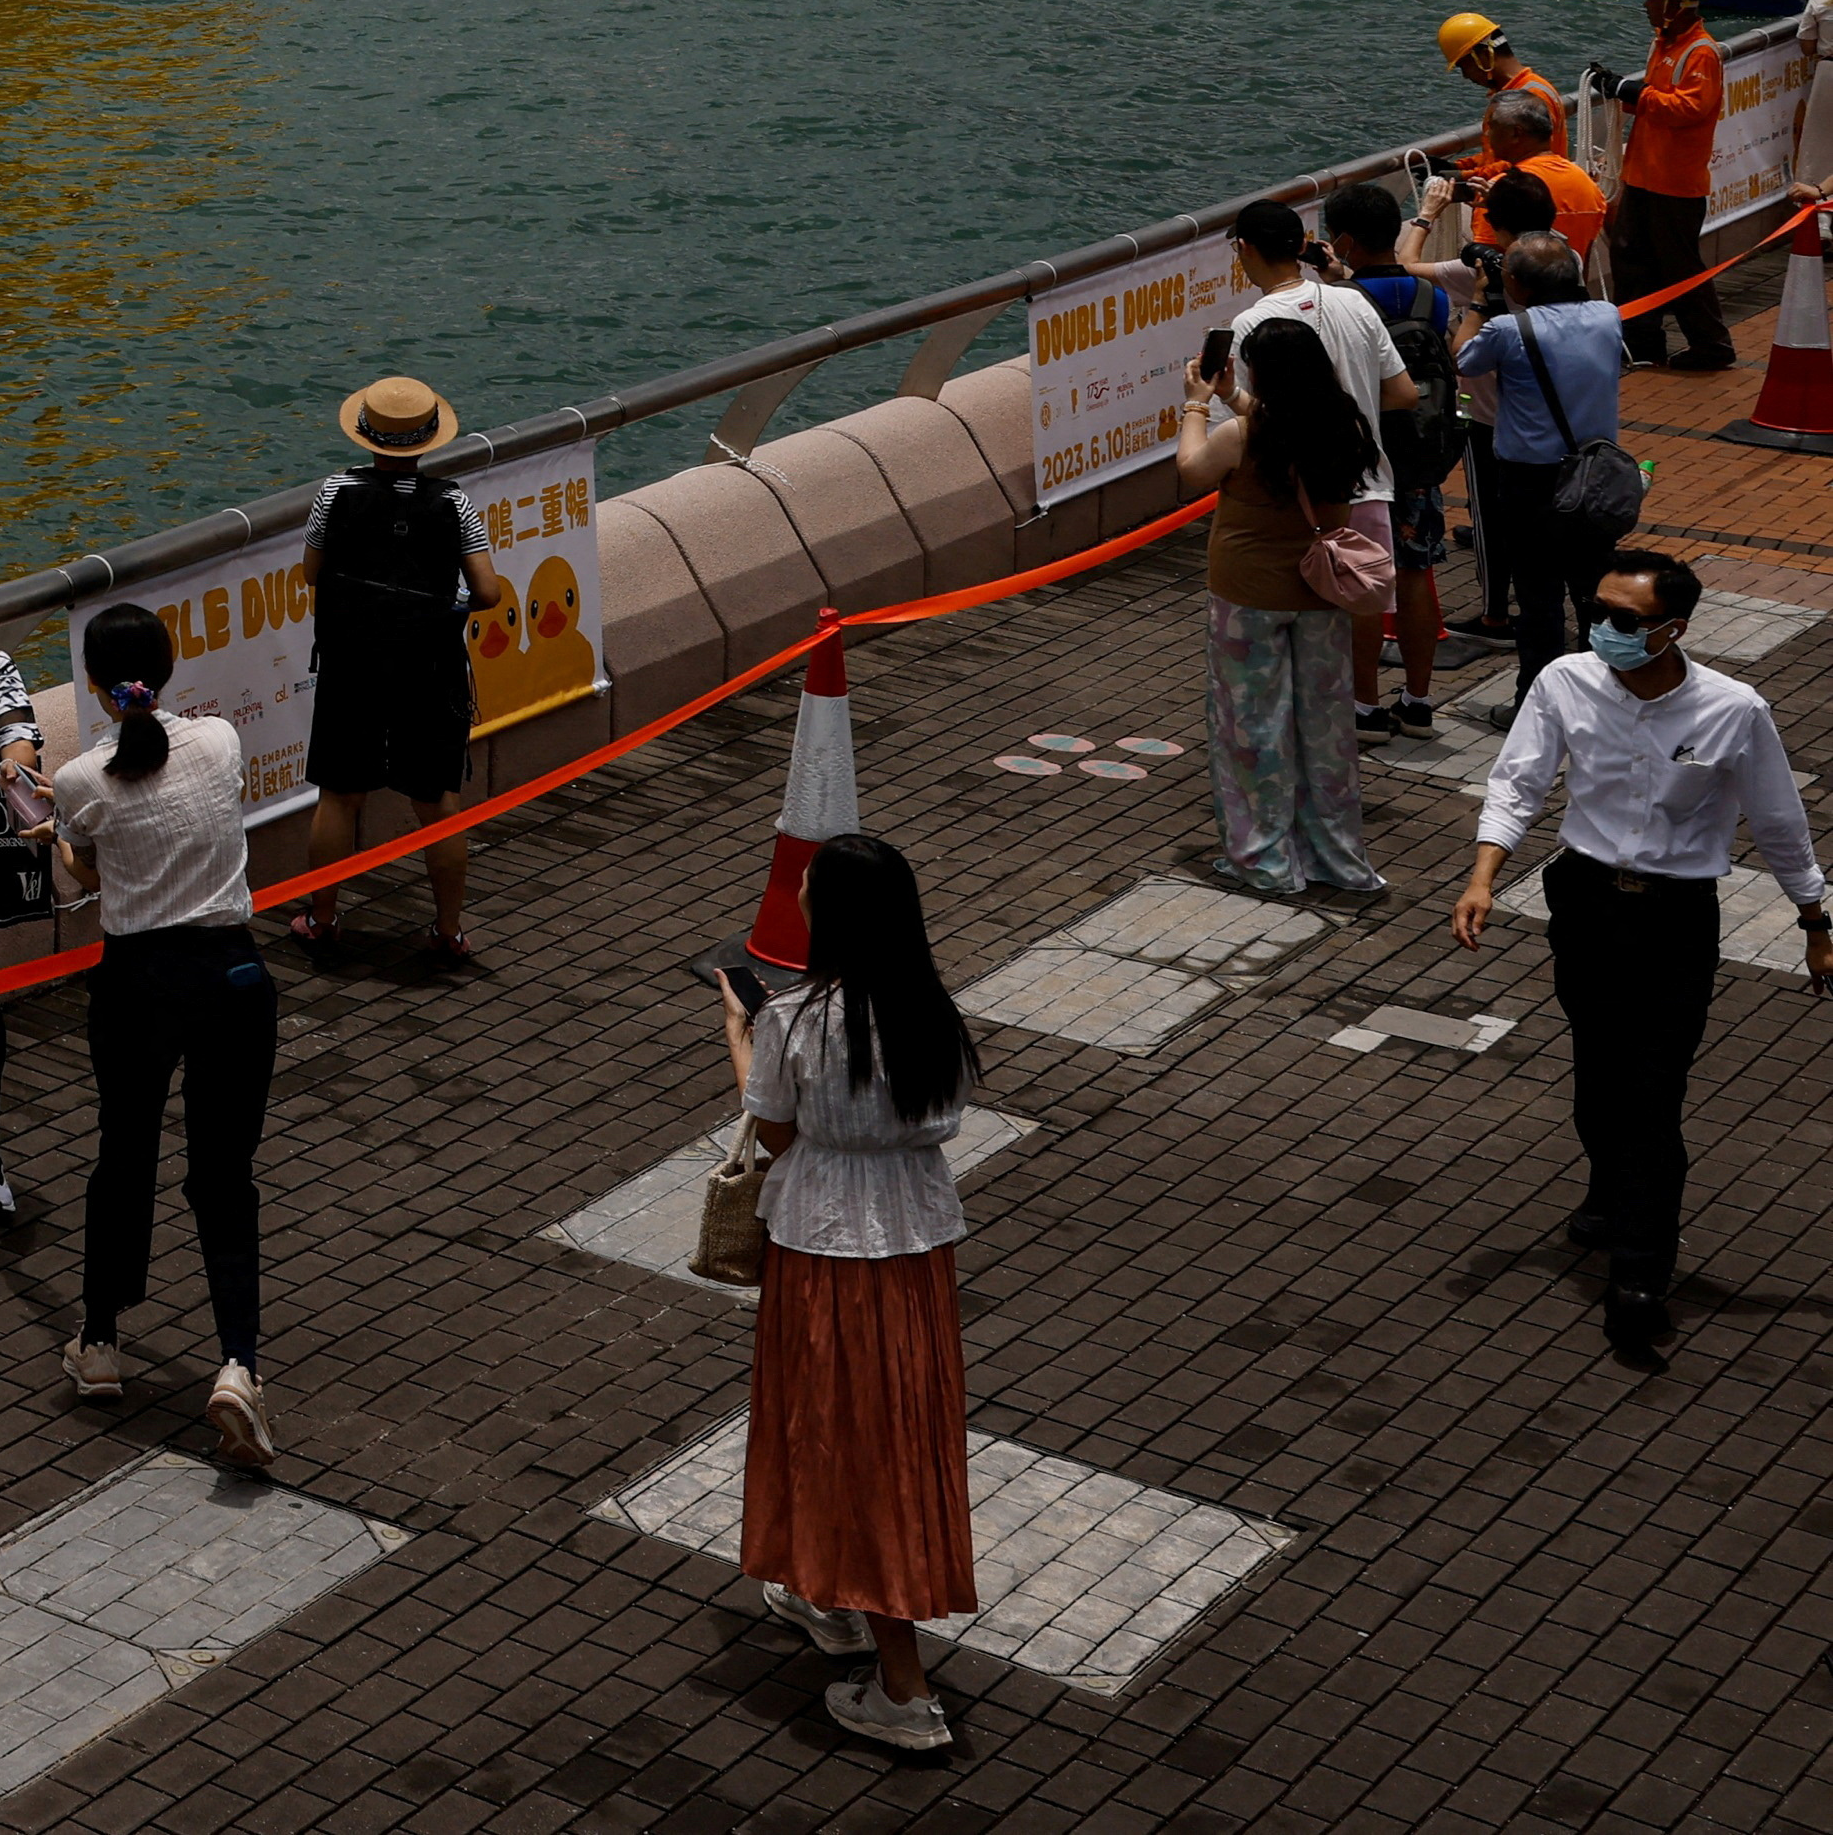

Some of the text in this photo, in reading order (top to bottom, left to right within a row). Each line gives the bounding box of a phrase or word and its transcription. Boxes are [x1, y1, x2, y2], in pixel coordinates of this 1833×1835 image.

[1189, 274, 1226, 298] FLORENTIJN
[1189, 293, 1216, 312] HOFMAN
[1036, 272, 1186, 366] DOUBLE DUCKS
[1042, 426, 1124, 490] 2023.6.10
[478, 477, 589, 554] 鴨二重暢
[156, 562, 316, 663] BLE DUC
[199, 699, 219, 713] YEARS
[233, 701, 263, 719] PRUDENTIAL
[262, 741, 304, 766] EMBARKS
[263, 758, 305, 797] 啟航!!
